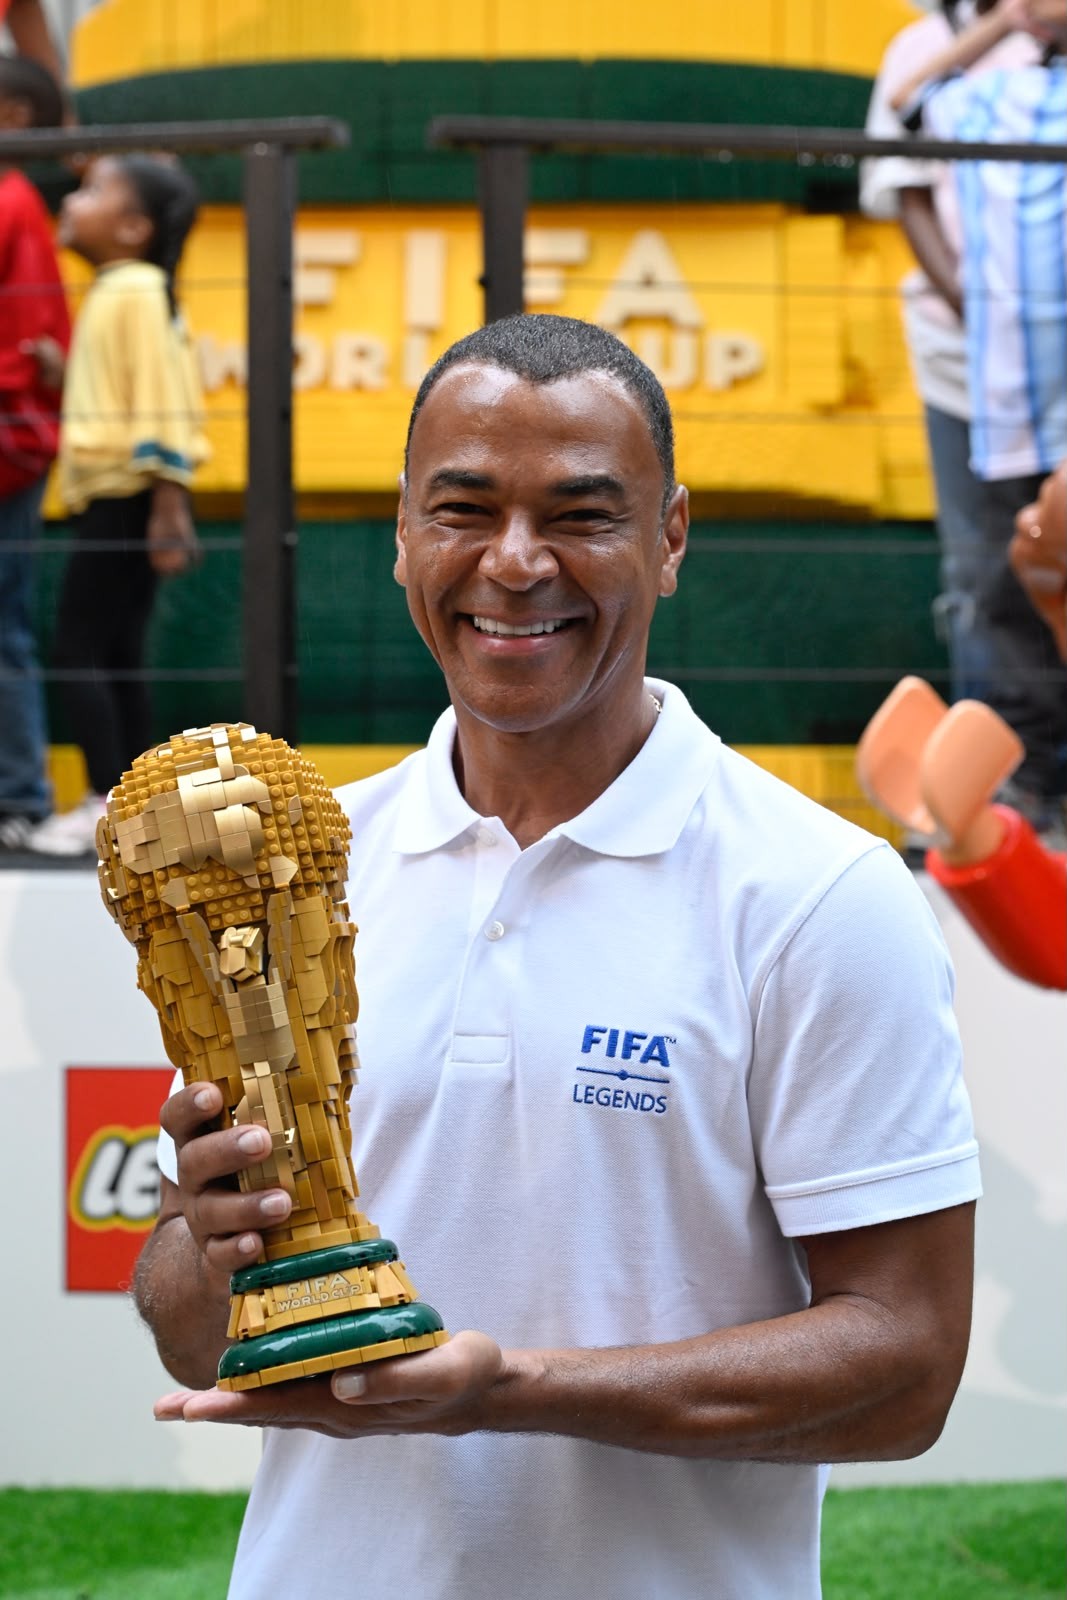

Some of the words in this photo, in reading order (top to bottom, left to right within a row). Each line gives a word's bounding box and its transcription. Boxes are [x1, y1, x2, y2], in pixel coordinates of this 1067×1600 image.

[196, 332, 432, 391] WORL
[613, 330, 765, 391] UP
[573, 1083, 668, 1114] LEGENDS
[76, 1132, 160, 1224] LE
[277, 1292, 330, 1313] WORLD
[331, 1284, 361, 1300] CUP
[287, 1272, 351, 1300] FIFA
